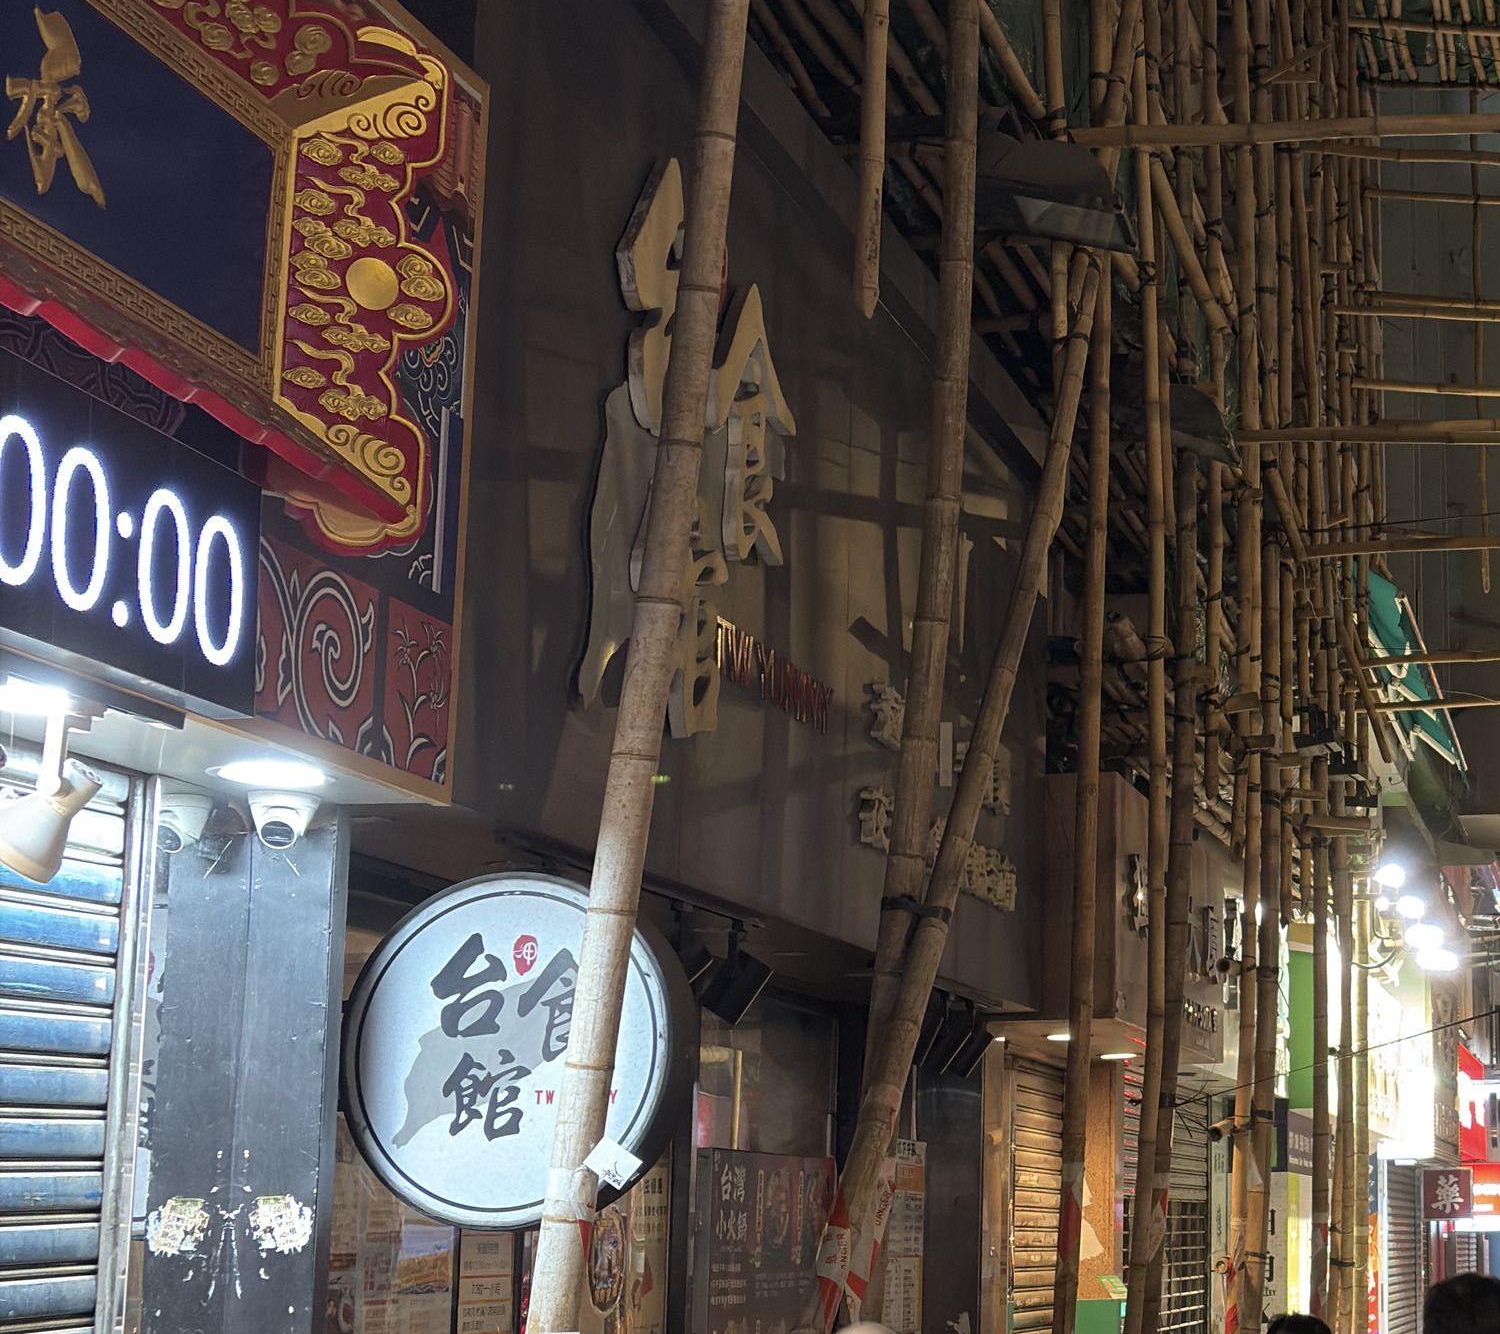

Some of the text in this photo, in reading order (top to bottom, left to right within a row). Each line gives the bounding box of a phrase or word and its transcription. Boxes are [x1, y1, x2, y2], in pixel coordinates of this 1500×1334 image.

[0, 414, 243, 666] 00:00
[442, 1049, 532, 1141] 館
[534, 1089, 555, 1105] TW
[1430, 1174, 1465, 1214] 藥
